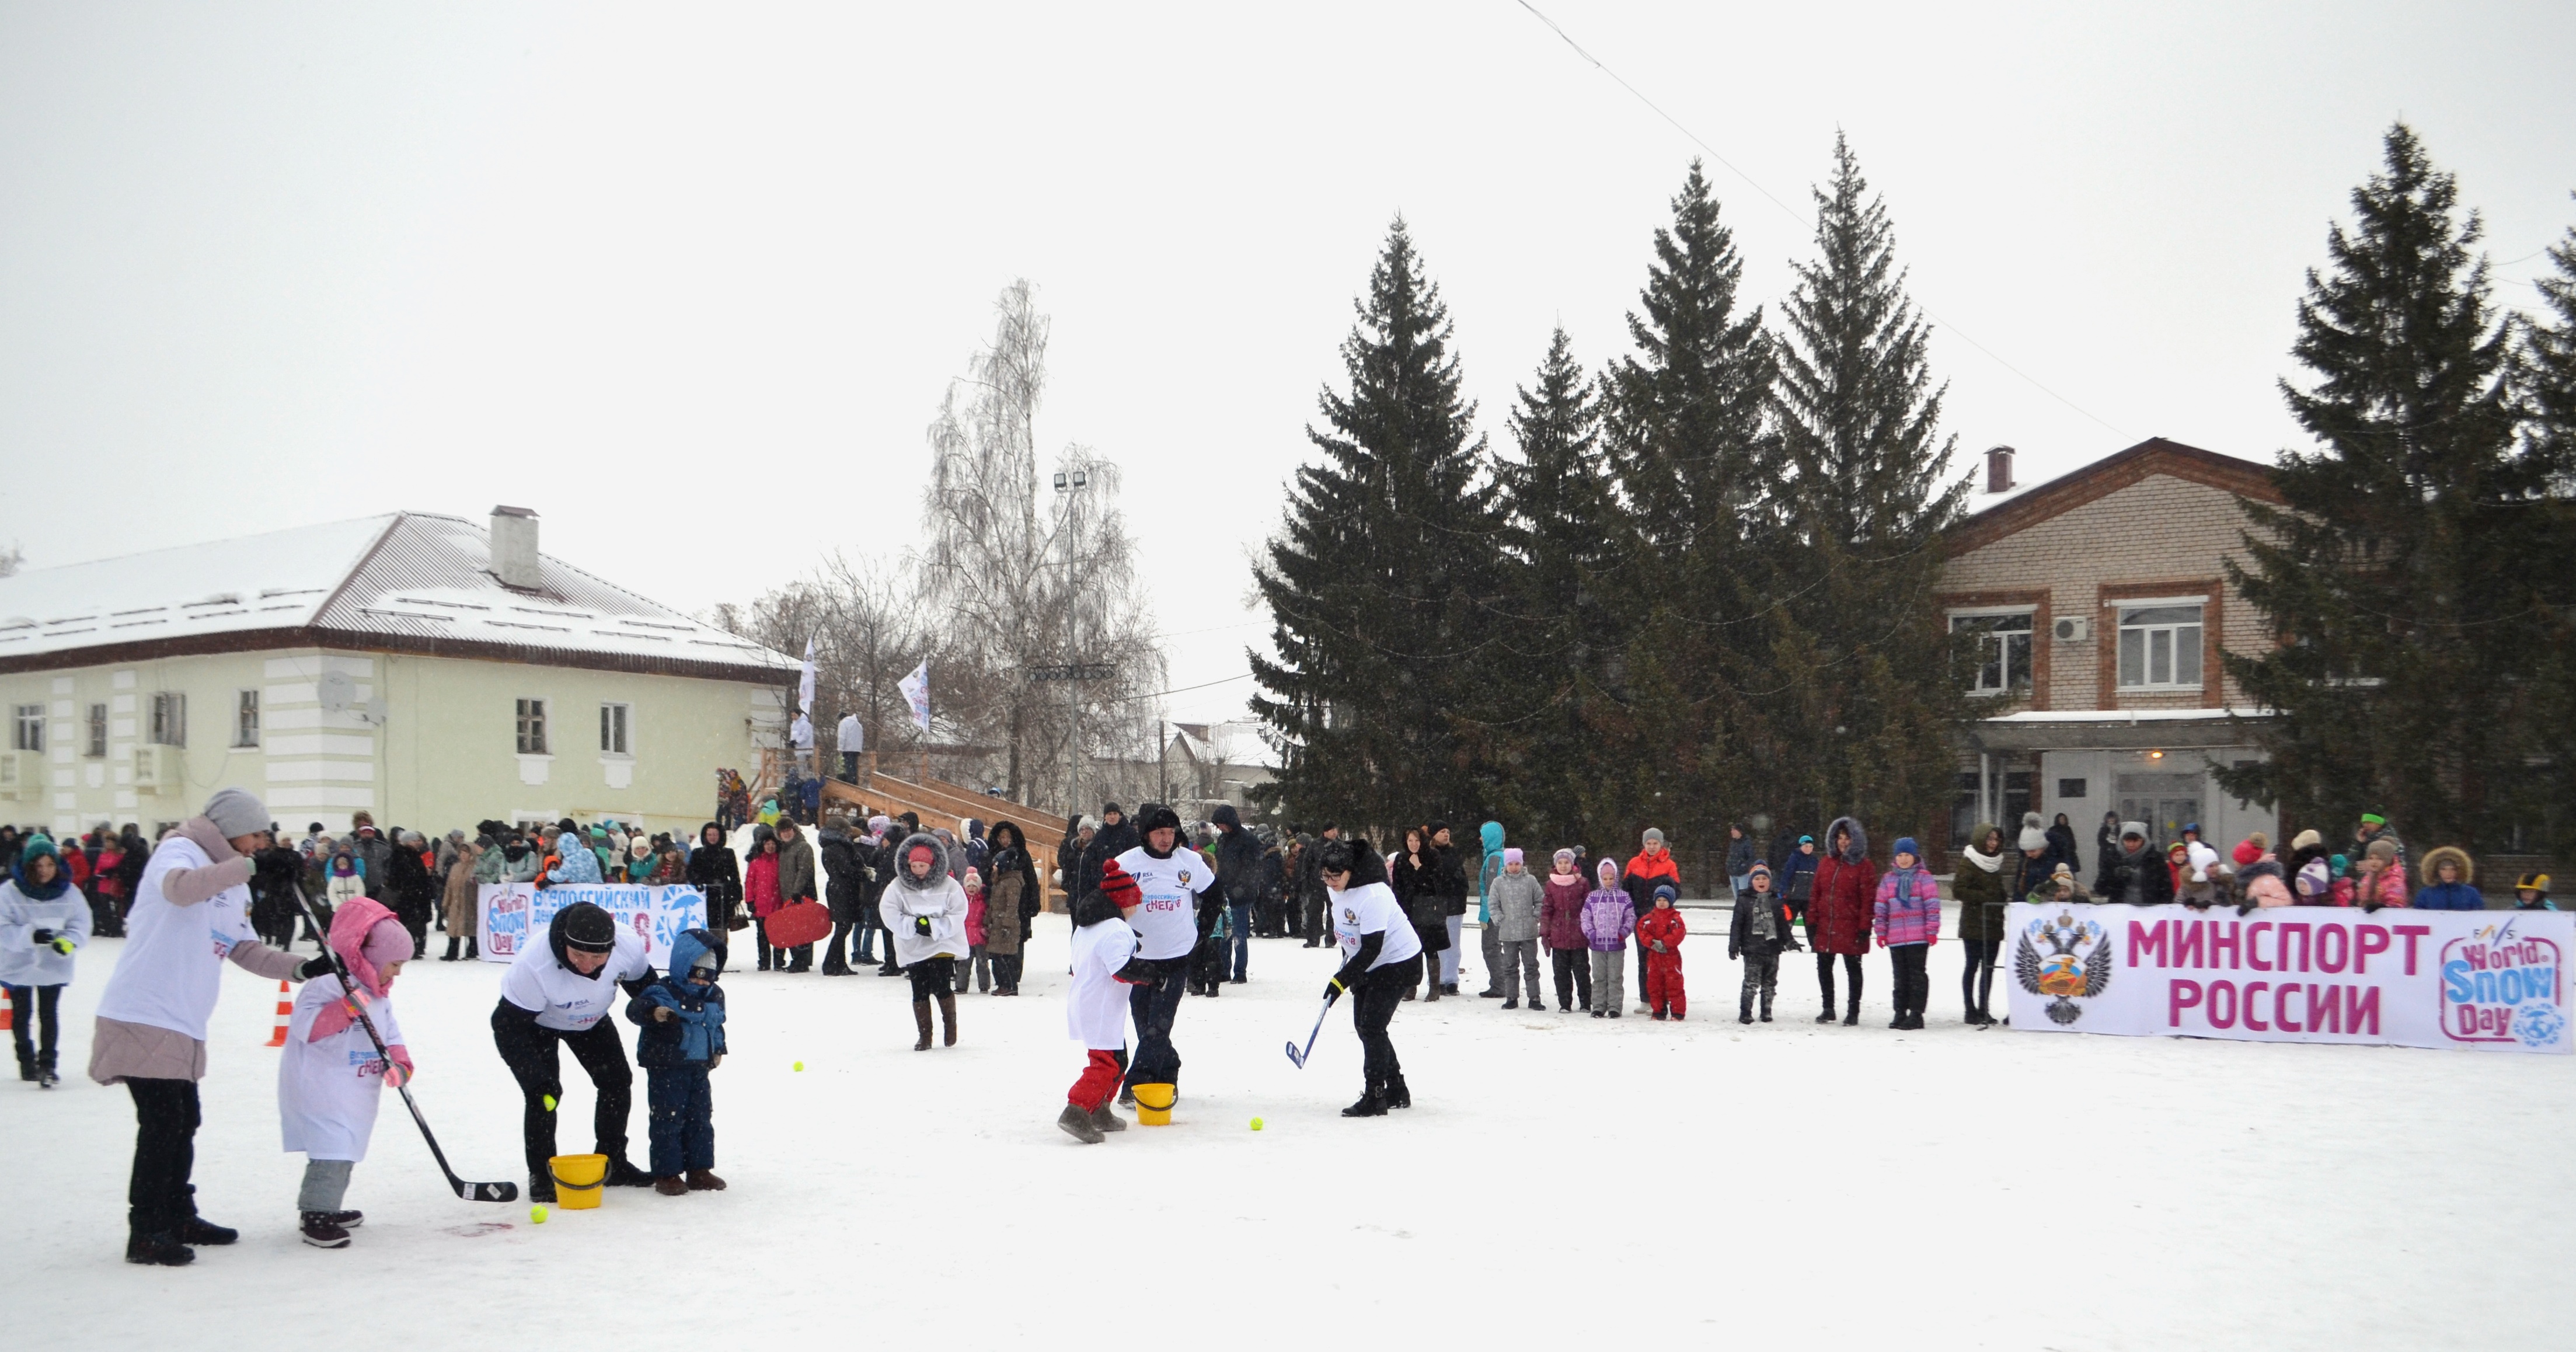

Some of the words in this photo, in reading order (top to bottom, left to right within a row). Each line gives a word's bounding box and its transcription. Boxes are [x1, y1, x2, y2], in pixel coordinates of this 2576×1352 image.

[2128, 919, 2430, 976] МИНСПОРТ
[2461, 942, 2539, 971] World
[2443, 960, 2553, 1005] Snow
[2169, 978, 2380, 1036] РОССИИ
[2457, 1003, 2512, 1037] Day
